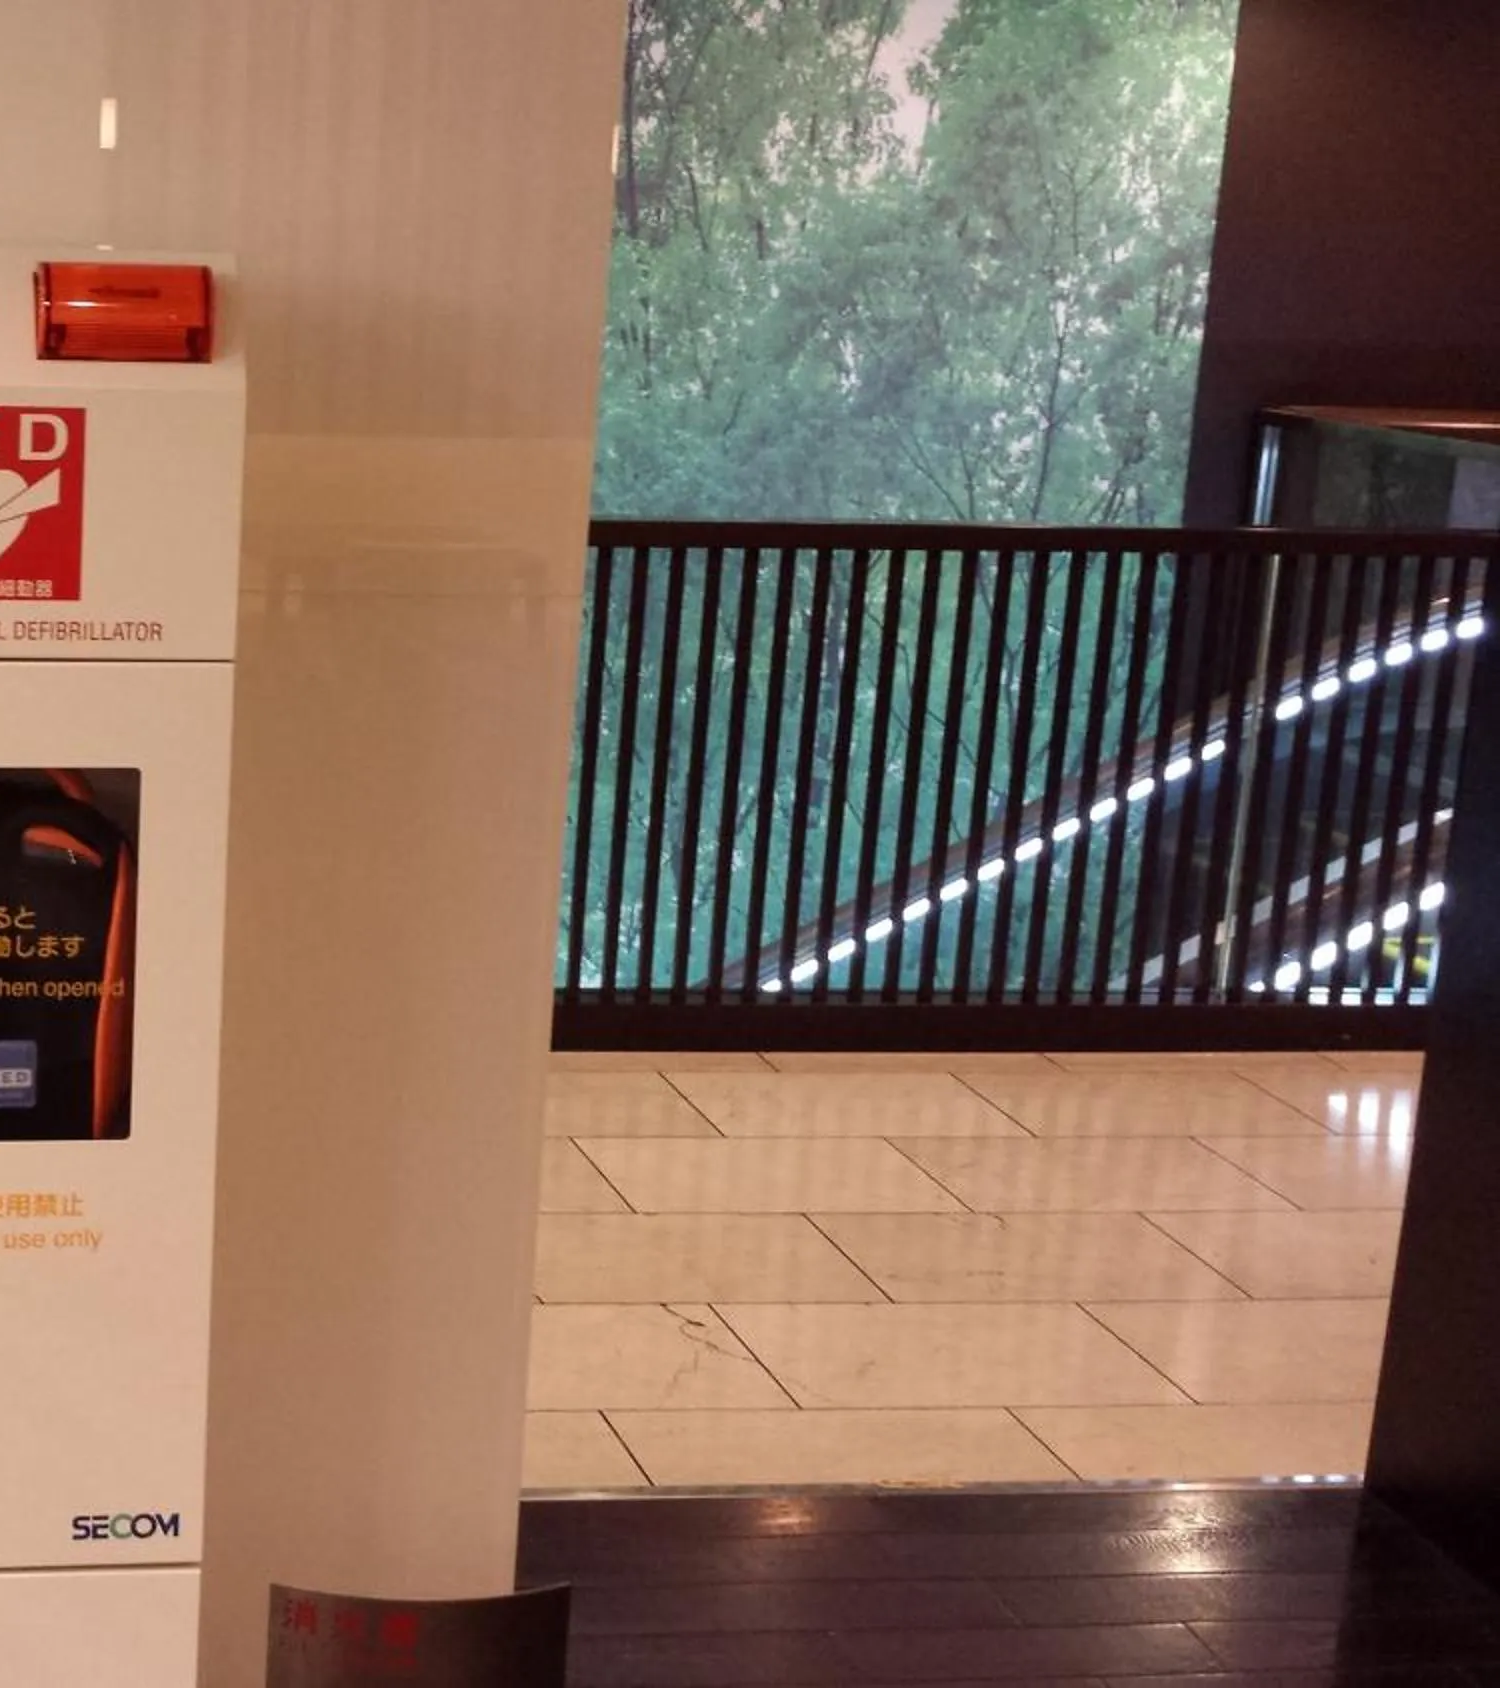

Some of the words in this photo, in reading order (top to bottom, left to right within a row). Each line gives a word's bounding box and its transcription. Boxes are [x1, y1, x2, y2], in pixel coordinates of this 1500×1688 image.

[14, 620, 163, 642] DEFIBRILLATOR
[44, 977, 126, 1001] opened
[3, 1232, 46, 1250] use
[52, 1227, 104, 1250] only
[71, 1513, 180, 1540] SECOM
